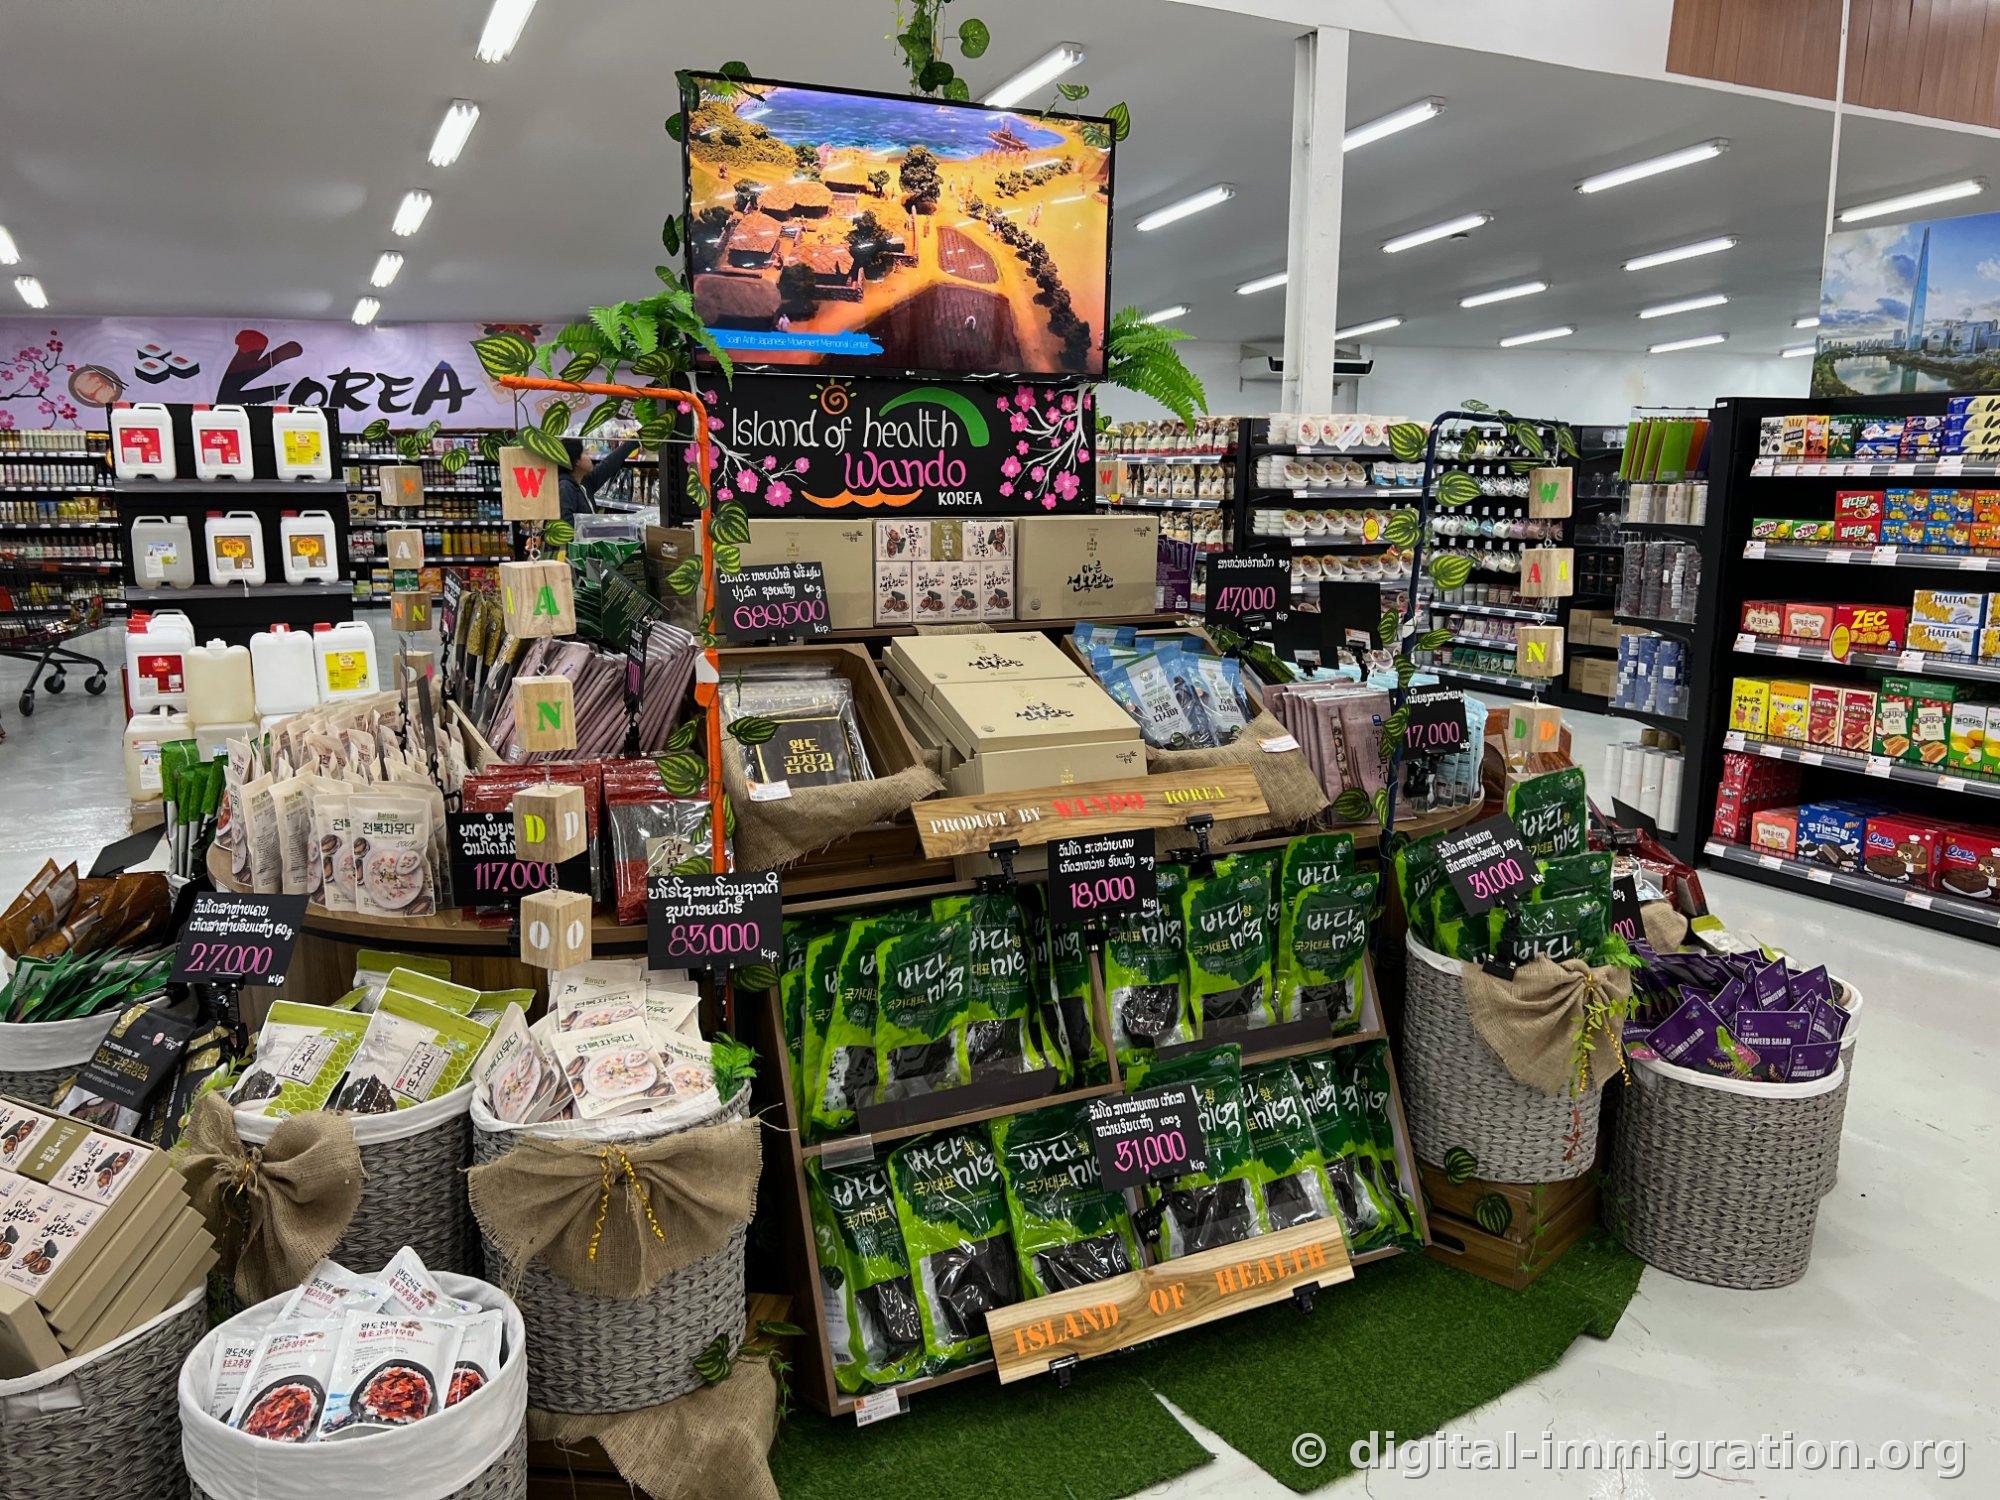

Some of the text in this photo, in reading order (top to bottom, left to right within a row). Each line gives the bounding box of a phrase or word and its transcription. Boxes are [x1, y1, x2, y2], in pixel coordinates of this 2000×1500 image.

[787, 337, 820, 347] Movement
[821, 338, 848, 348] Memorial
[850, 339, 869, 349] Center
[215, 329, 477, 415] KOREA
[732, 406, 958, 456] Island of health
[513, 466, 547, 498] W
[844, 449, 967, 489] Wando
[1099, 470, 1113, 485] W
[938, 491, 983, 506] KOREA
[1536, 482, 1560, 504] W
[1842, 495, 1869, 508] 닭다리
[396, 541, 412, 559] A
[1082, 560, 1102, 574] 마른
[1526, 562, 1542, 583] A
[1555, 561, 1569, 581] A
[394, 603, 403, 618] N
[533, 586, 560, 615] A
[1215, 586, 1276, 617] 47,000
[1934, 594, 1967, 604] HAITAI
[412, 605, 426, 621] N
[734, 600, 826, 629] 689,500
[1851, 610, 1888, 629] ZEC
[1928, 628, 1960, 638] HAITAI
[1527, 642, 1546, 663] N
[537, 702, 562, 732] N
[1153, 708, 1179, 723] 다시마
[1514, 717, 1527, 740] D
[1405, 721, 1460, 748] 17,000
[1539, 720, 1555, 740] D
[788, 738, 820, 755] 완도
[783, 752, 834, 775] 곱창김
[930, 785, 1226, 835] PRODUCT BY WANDO KOREA
[1521, 808, 1563, 837] 바다
[362, 822, 415, 835] 전복차우더
[523, 814, 546, 843] D
[564, 811, 579, 841] D
[1297, 864, 1340, 886] 바다
[1468, 858, 1524, 898] 31,000
[1069, 876, 1135, 909] 18,000
[1201, 902, 1244, 932] 바다
[1308, 909, 1354, 931] 바다
[668, 922, 760, 956] 83,000
[1142, 920, 1181, 949] 미역
[1193, 917, 1262, 955] 국가대표 미역
[1295, 919, 1365, 952] 국가대표 미역
[898, 953, 947, 988] 바다
[970, 951, 1028, 983] 대표 미역
[574, 994, 630, 1009] 전복차우더
[887, 967, 964, 1010] 국가대표 미역
[575, 1033, 635, 1053] 전복차우더
[1740, 1037, 1791, 1045] SEAWEED SALAD
[407, 1053, 434, 1094] 김자반
[1253, 1095, 1302, 1131] 미역
[1303, 1084, 1339, 1117] 미역
[1197, 1100, 1241, 1137] 미역
[1020, 1141, 1079, 1172] 바다
[1114, 1131, 1186, 1174] 31,000
[913, 1176, 956, 1195] 국가대표
[1025, 1174, 1071, 1194] 국가대표
[842, 1203, 890, 1228] 국가대표
[1013, 1242, 1326, 1357] ISLAND OF HEALTH
